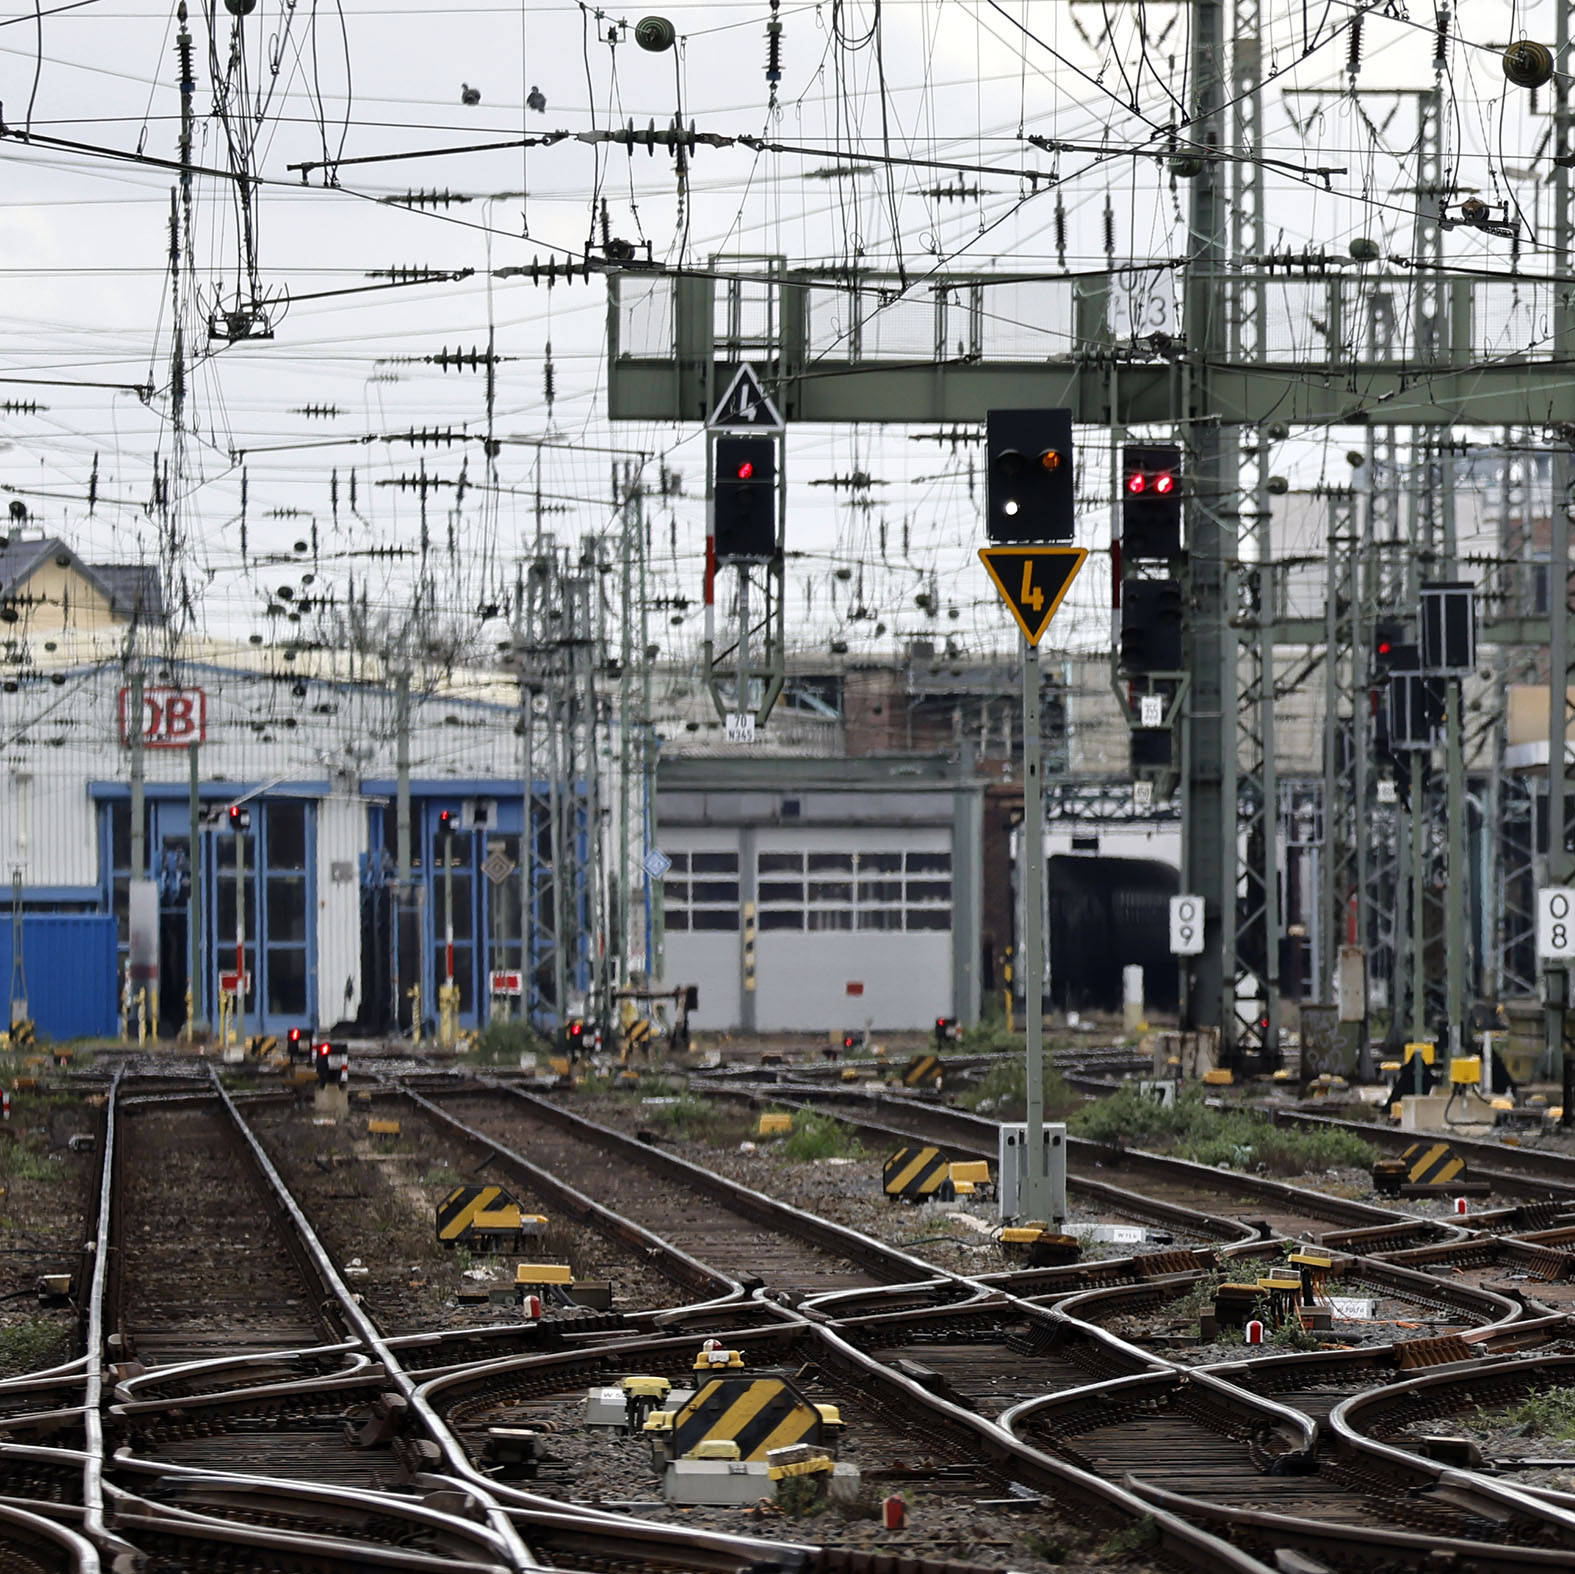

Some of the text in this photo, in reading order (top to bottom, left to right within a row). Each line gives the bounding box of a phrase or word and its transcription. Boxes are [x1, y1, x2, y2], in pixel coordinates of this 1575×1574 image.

[740, 384, 758, 422] 4
[1021, 560, 1044, 611] 4
[1179, 902, 1194, 921] 0
[1551, 894, 1569, 919] 0
[1180, 926, 1193, 947] 9
[1552, 923, 1567, 949] 8
